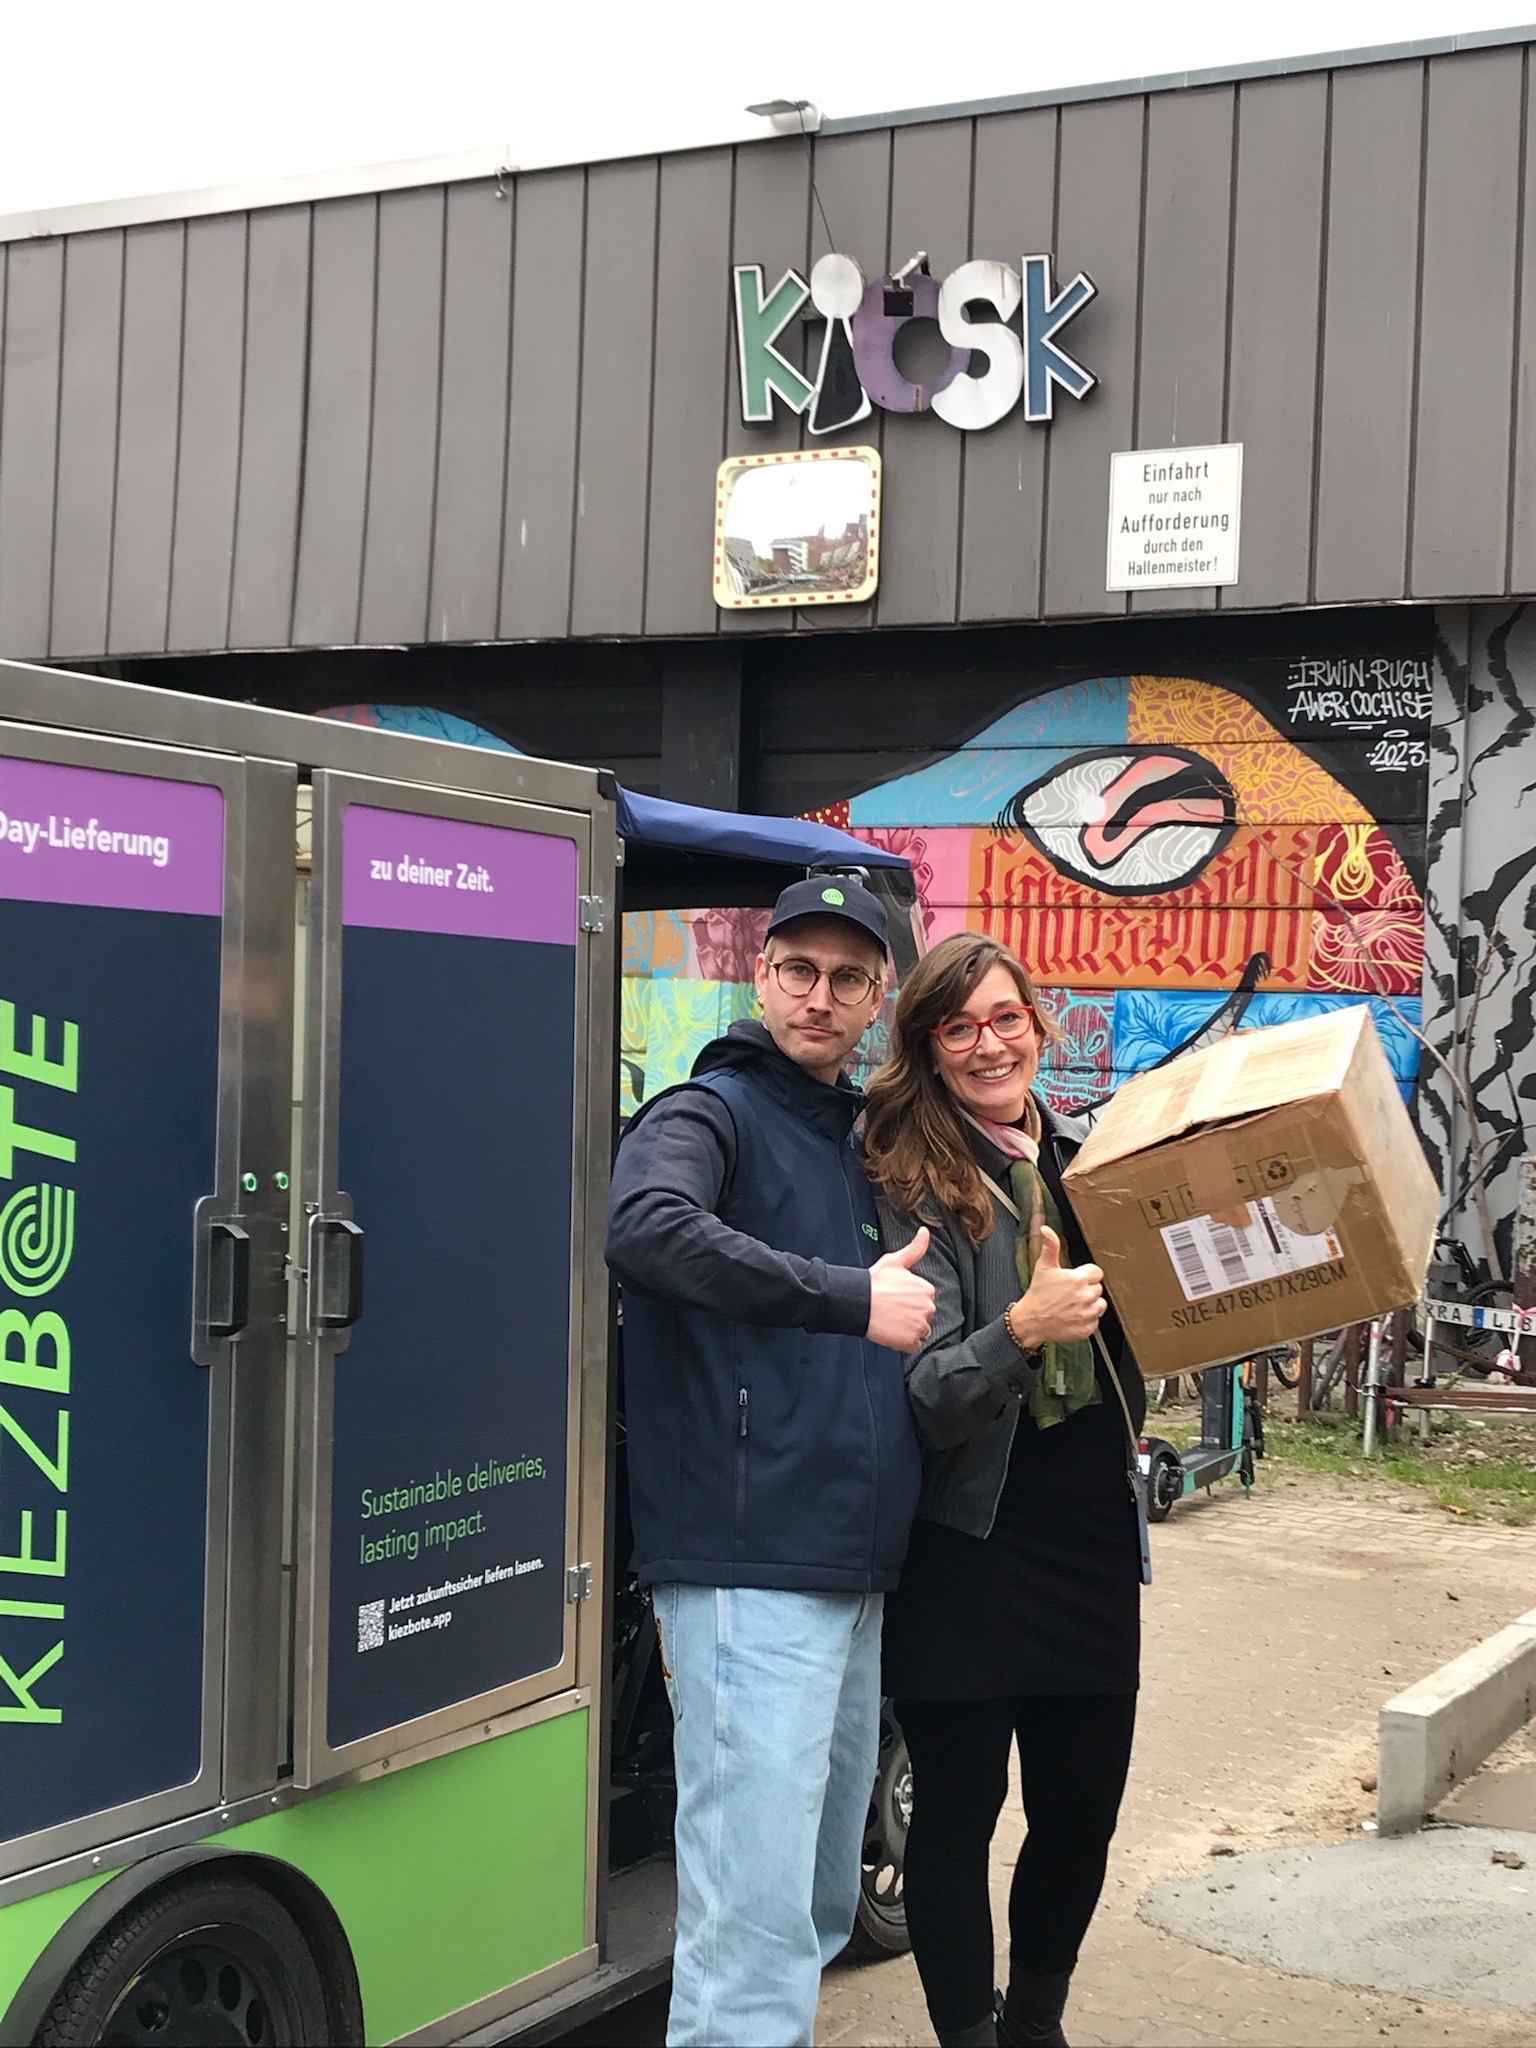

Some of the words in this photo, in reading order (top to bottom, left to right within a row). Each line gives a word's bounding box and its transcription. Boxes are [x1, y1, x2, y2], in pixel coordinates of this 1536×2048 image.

[1143, 461, 1209, 482] Einfahrt
[1149, 492, 1169, 504] nur
[1173, 487, 1201, 503] nach
[1120, 512, 1229, 534] Aufforderung
[1144, 538, 1177, 554] durch
[1181, 537, 1203, 552] den
[370, 859, 393, 881] zu
[397, 854, 453, 887] deiner
[456, 863, 494, 892] Zeit.
[360, 1468, 463, 1519] Sustainable
[466, 1454, 547, 1493] deliveries,
[360, 1529, 420, 1565] lasting
[425, 1510, 487, 1552] impact.
[388, 1593, 415, 1615] Jetzt
[416, 1573, 484, 1606] zukunftssicher
[484, 1565, 514, 1585] liefern
[515, 1557, 545, 1576] lassen.
[388, 1610, 453, 1642] kiezbote.app
